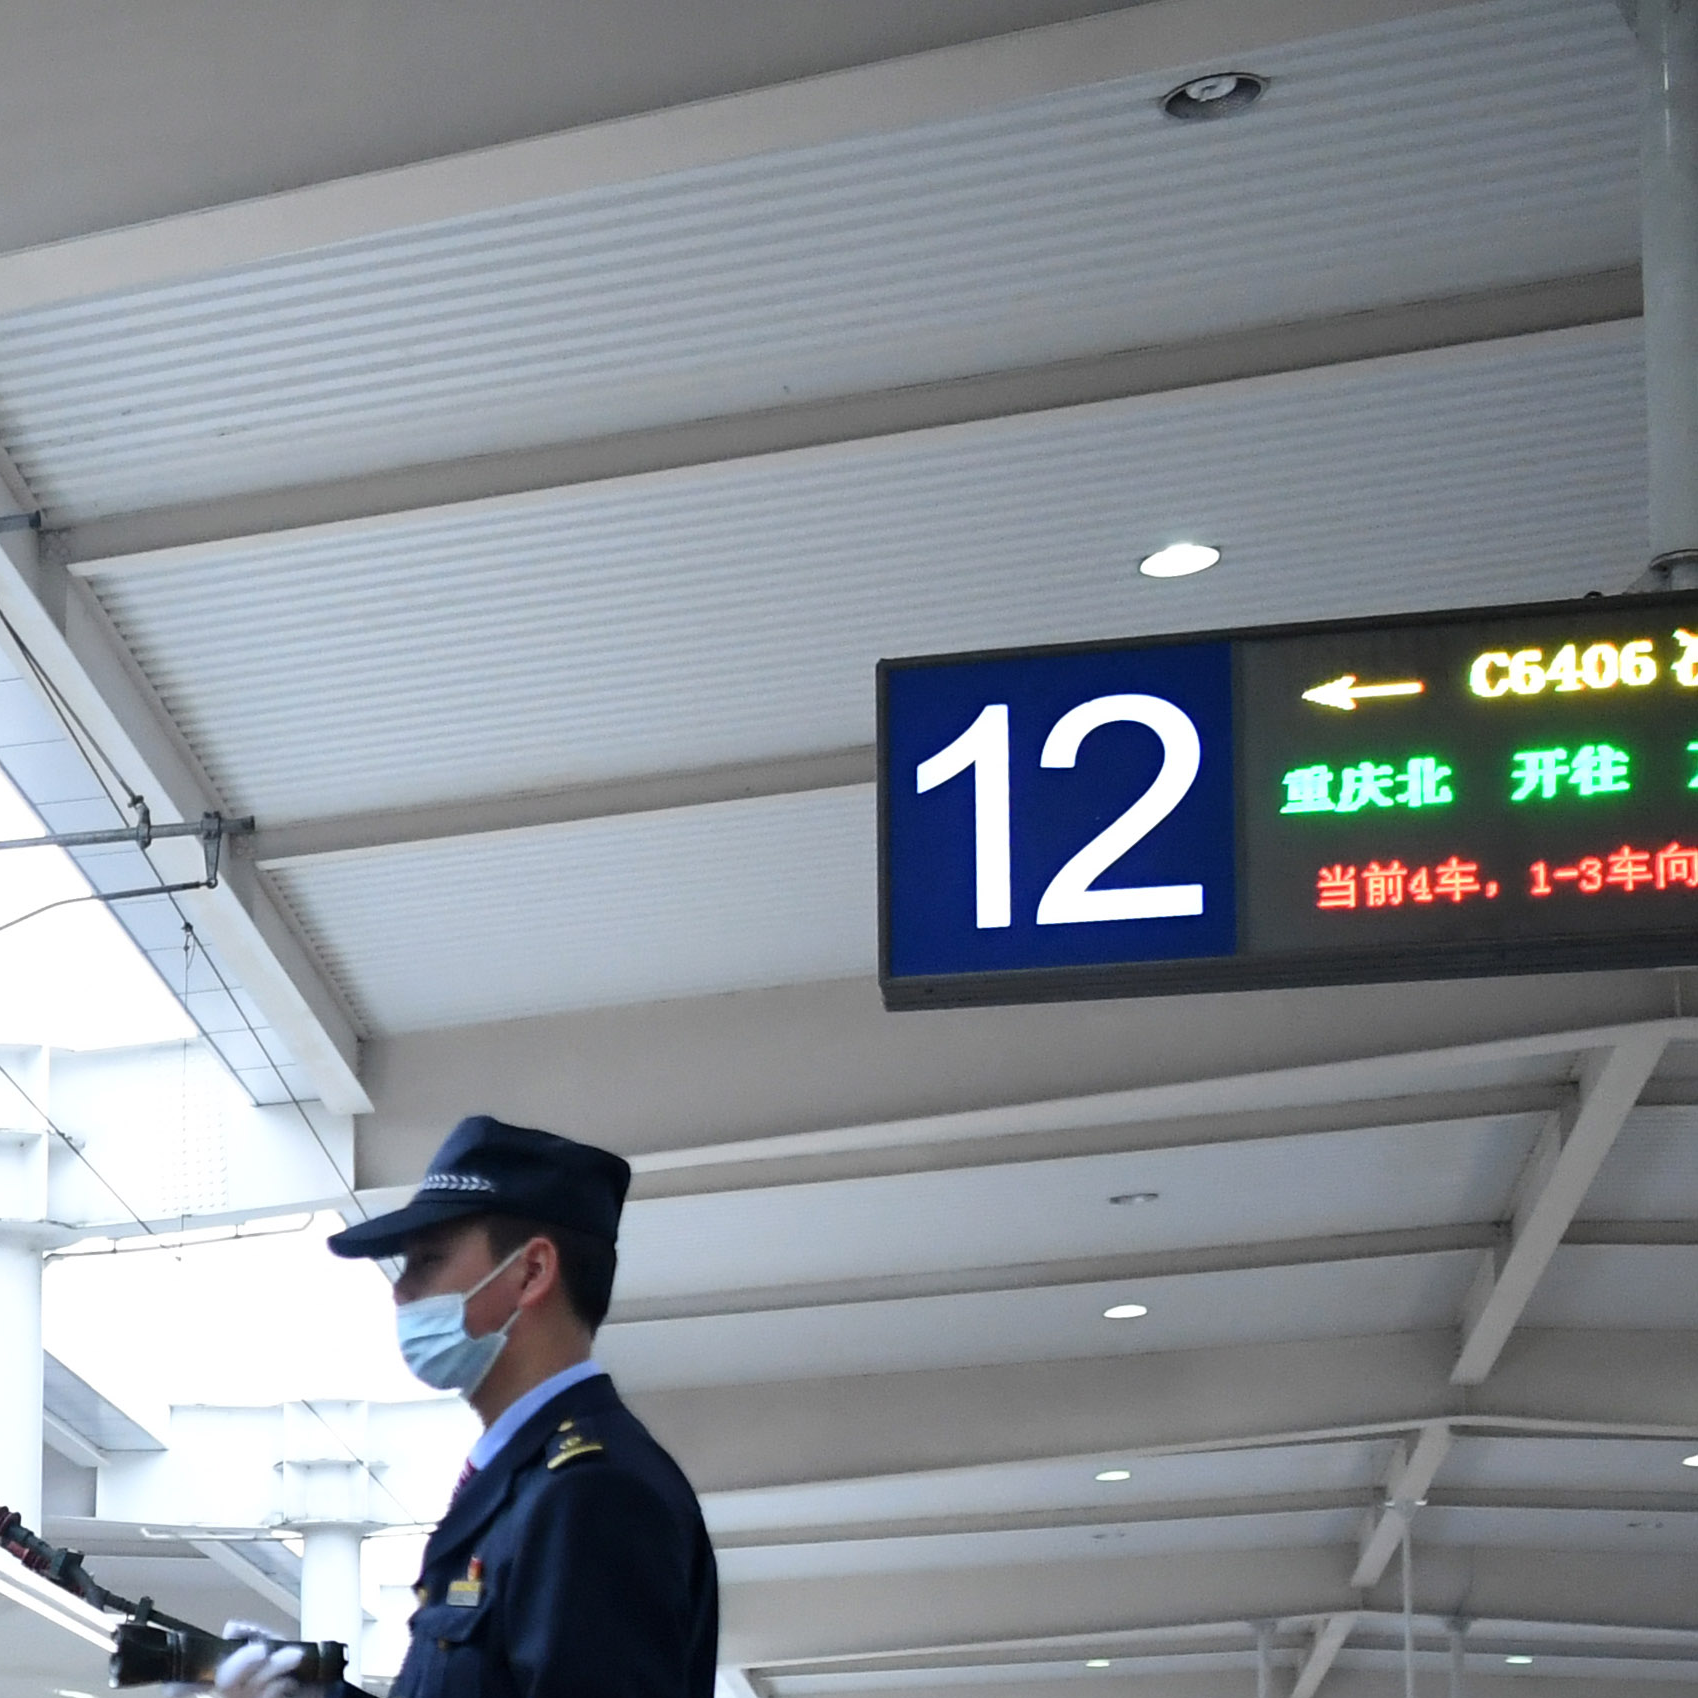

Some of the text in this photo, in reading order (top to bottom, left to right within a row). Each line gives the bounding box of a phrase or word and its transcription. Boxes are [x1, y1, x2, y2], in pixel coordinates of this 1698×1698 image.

[917, 692, 1204, 930] 12
[1280, 757, 1453, 814] 重庆北
[1510, 744, 1631, 801] 开往
